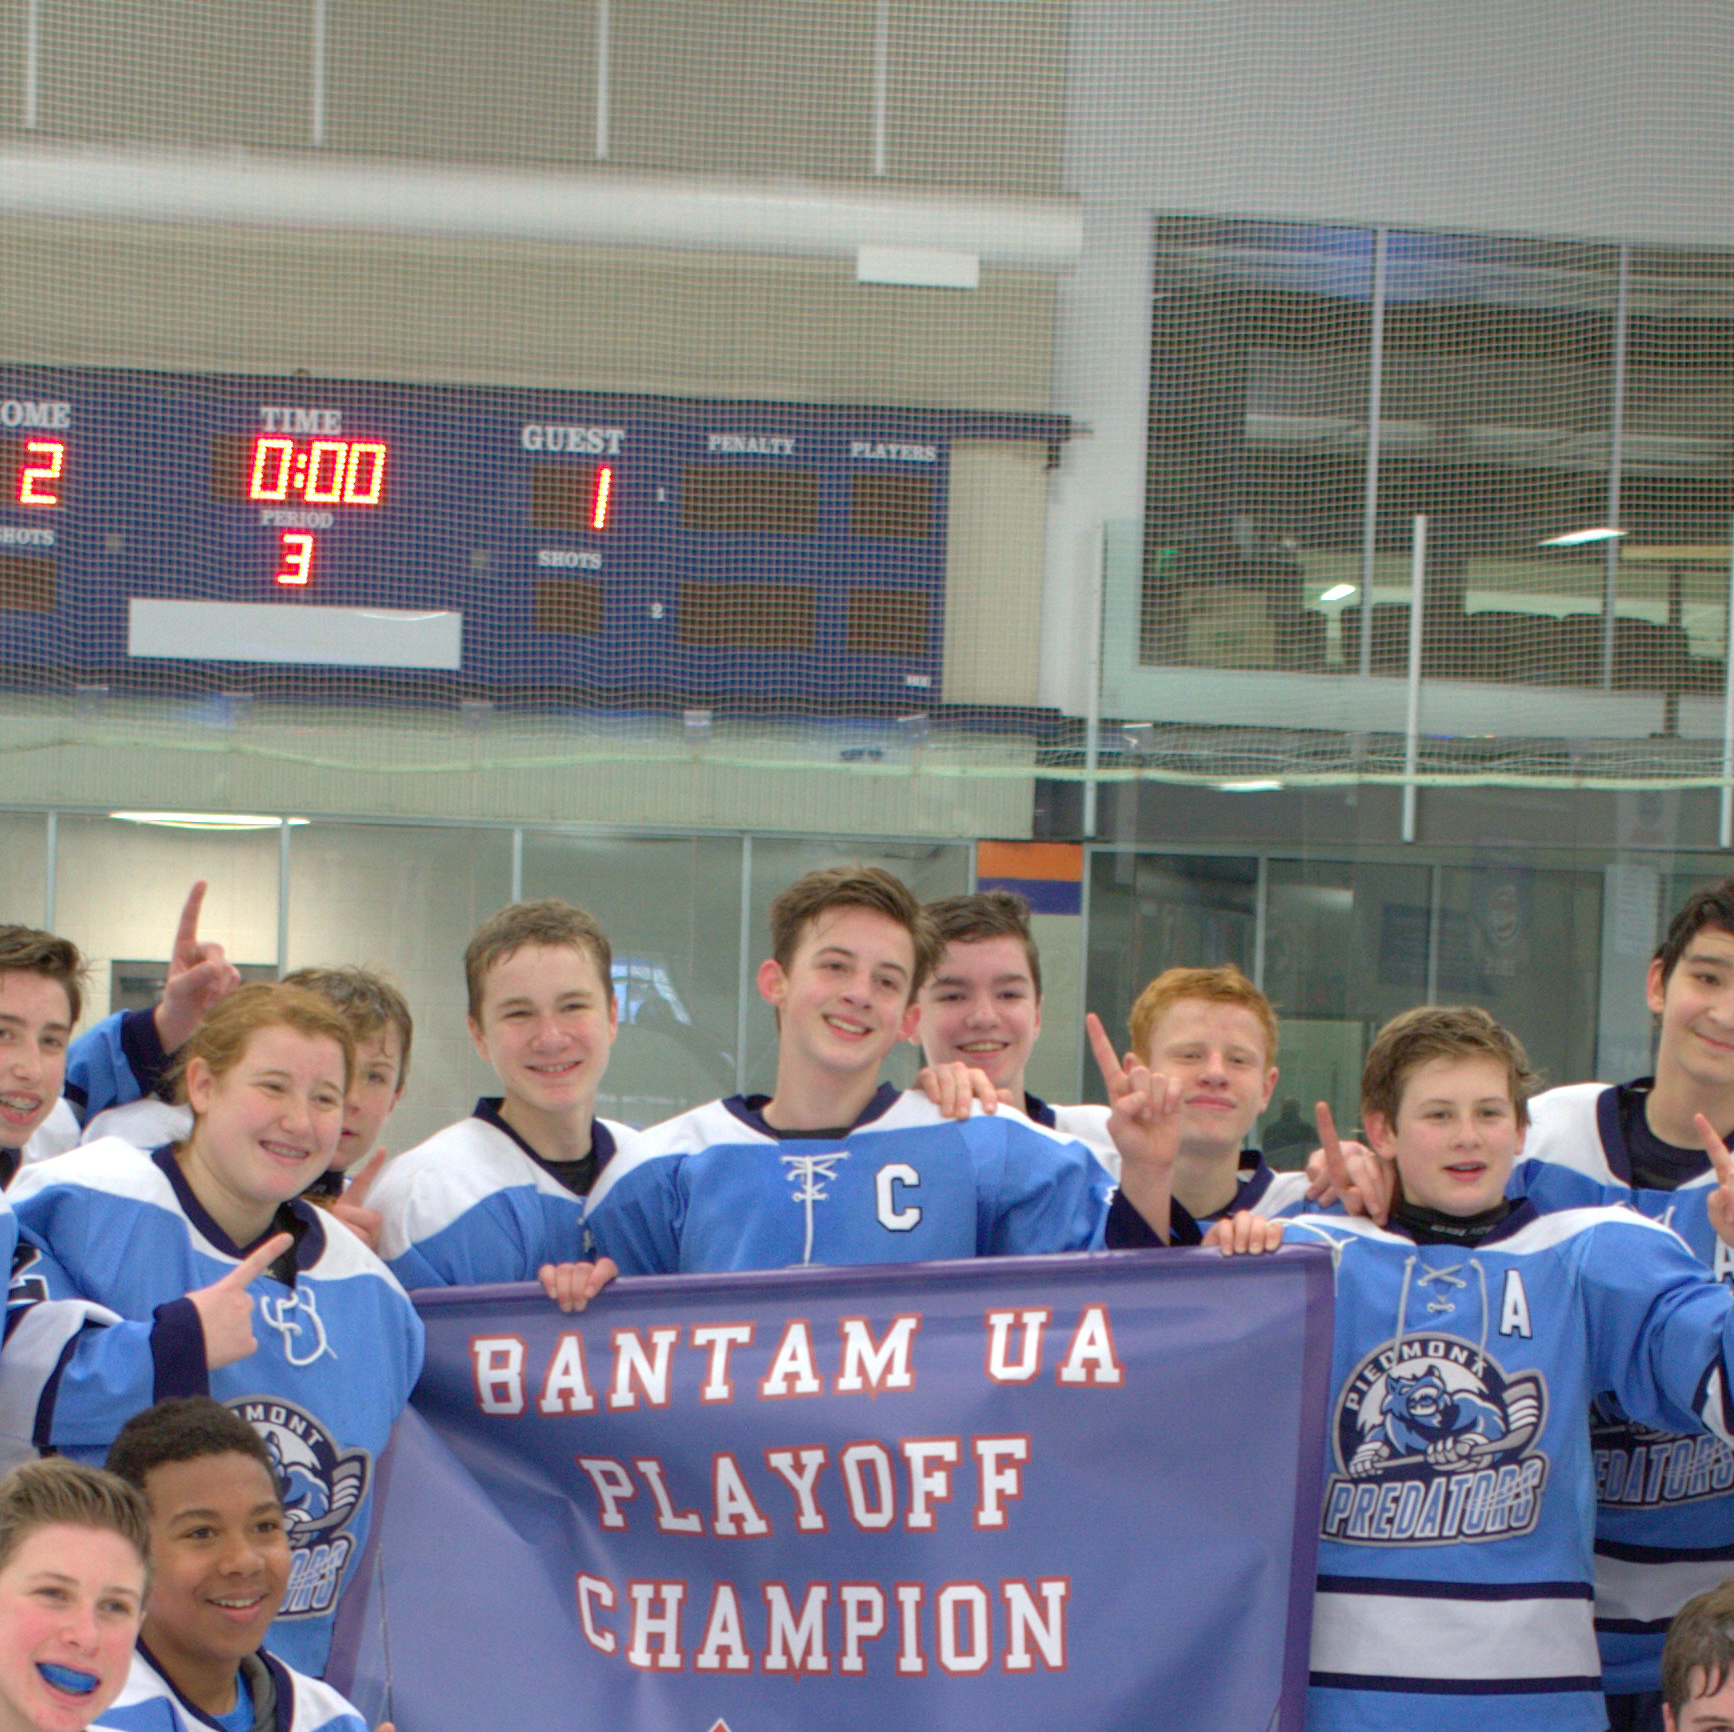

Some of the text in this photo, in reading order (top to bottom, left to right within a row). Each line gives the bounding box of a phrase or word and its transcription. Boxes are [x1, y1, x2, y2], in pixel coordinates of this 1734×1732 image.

[260, 406, 343, 437] TIME
[521, 423, 626, 456] GUEST
[708, 433, 938, 463] PENALTY PLAYERS
[19, 439, 65, 506] 2
[249, 436, 387, 506] 0:00
[592, 465, 612, 530] 1
[260, 509, 335, 530] PERIOD
[276, 533, 315, 585] 3
[537, 549, 602, 571] SHOTS
[875, 1163, 922, 1234] C
[1499, 1267, 1534, 1340] A
[470, 1303, 1125, 1418] BANTAM UA
[1344, 1340, 1489, 1413] PIEDMONT
[576, 1434, 1032, 1539] PLAYOFF
[1324, 1457, 1545, 1541] PREDATORS
[576, 1570, 1072, 1677] CHAMPION
